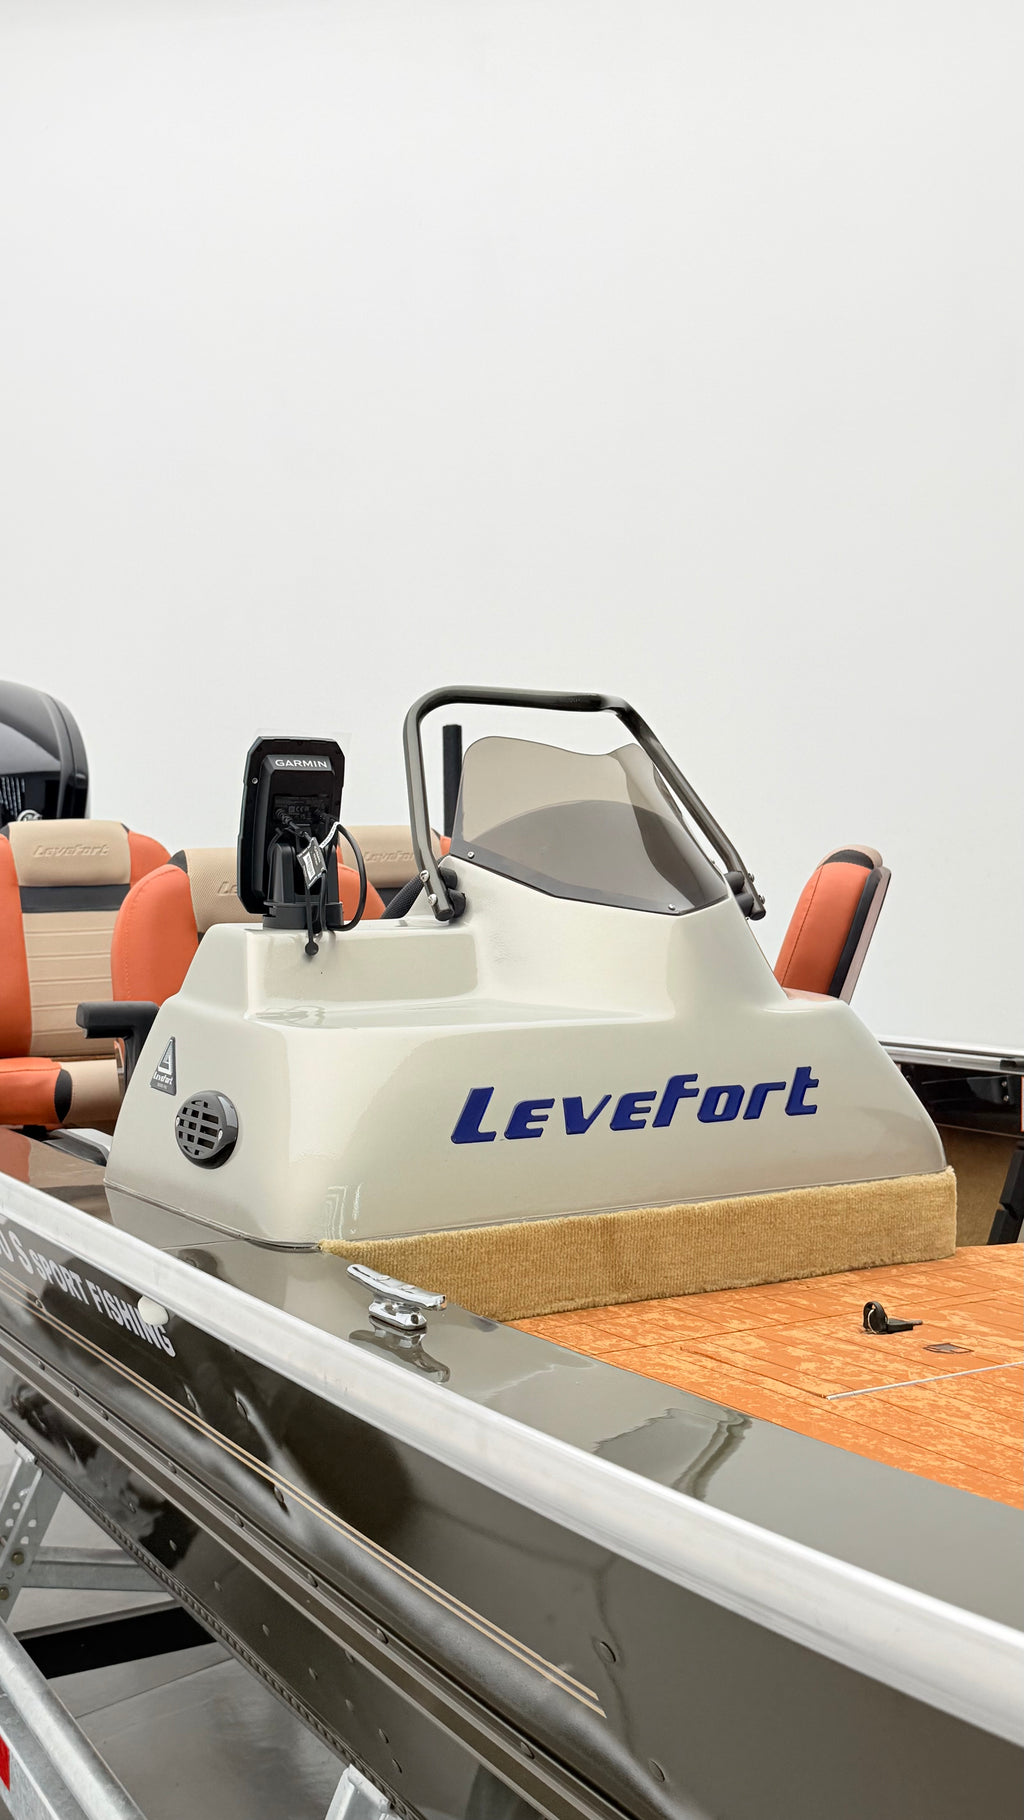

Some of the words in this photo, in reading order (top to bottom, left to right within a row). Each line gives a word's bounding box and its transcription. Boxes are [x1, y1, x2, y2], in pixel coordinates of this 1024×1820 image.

[275, 759, 328, 768] GARMIN
[8, 1230, 34, 1275] S
[29, 1249, 90, 1305] SPORT
[85, 1279, 176, 1358] FISHING
